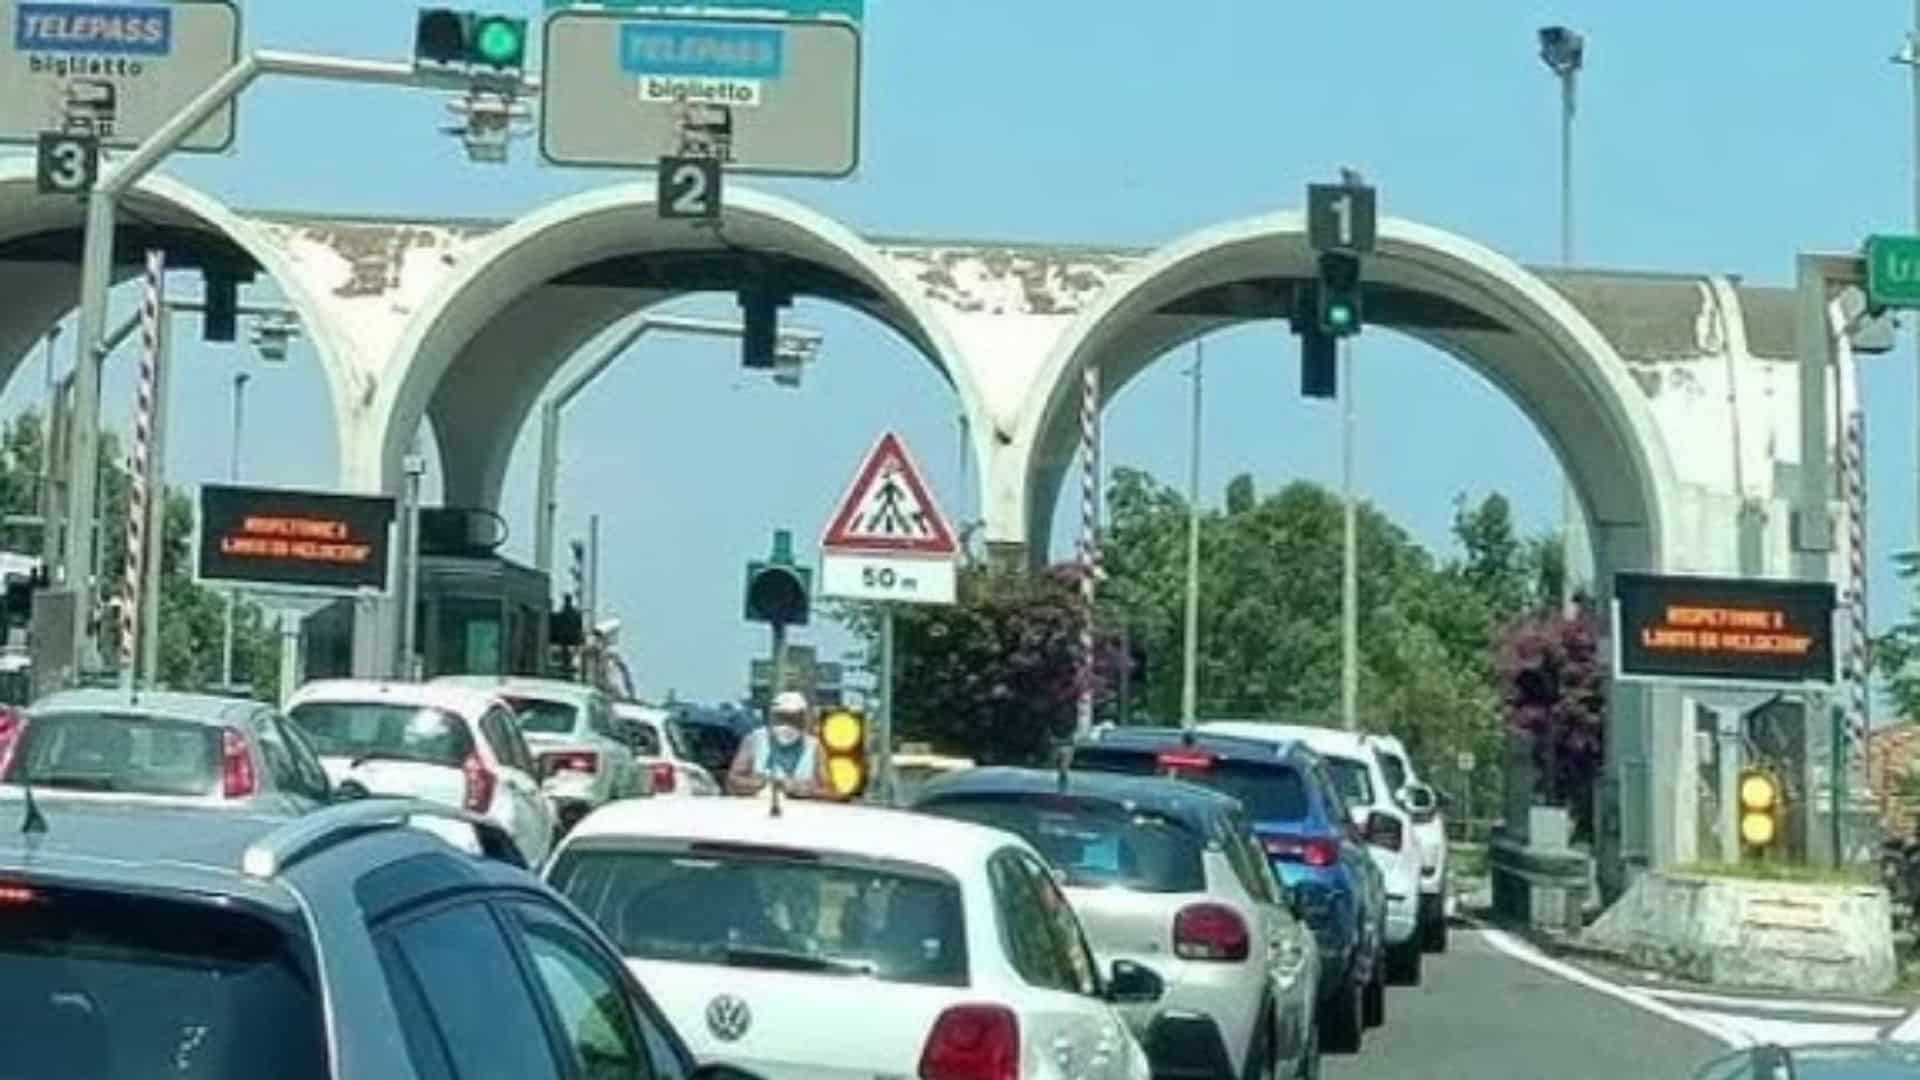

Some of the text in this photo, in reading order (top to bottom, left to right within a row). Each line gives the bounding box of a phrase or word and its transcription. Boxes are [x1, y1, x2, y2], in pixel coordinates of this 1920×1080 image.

[23, 15, 162, 42] TELEPASS
[30, 56, 142, 77] biglietto
[648, 79, 754, 102] biglietto
[51, 141, 85, 189] 3
[671, 165, 707, 215] 2
[1331, 194, 1352, 245] 1
[862, 567, 918, 592] 50 m
